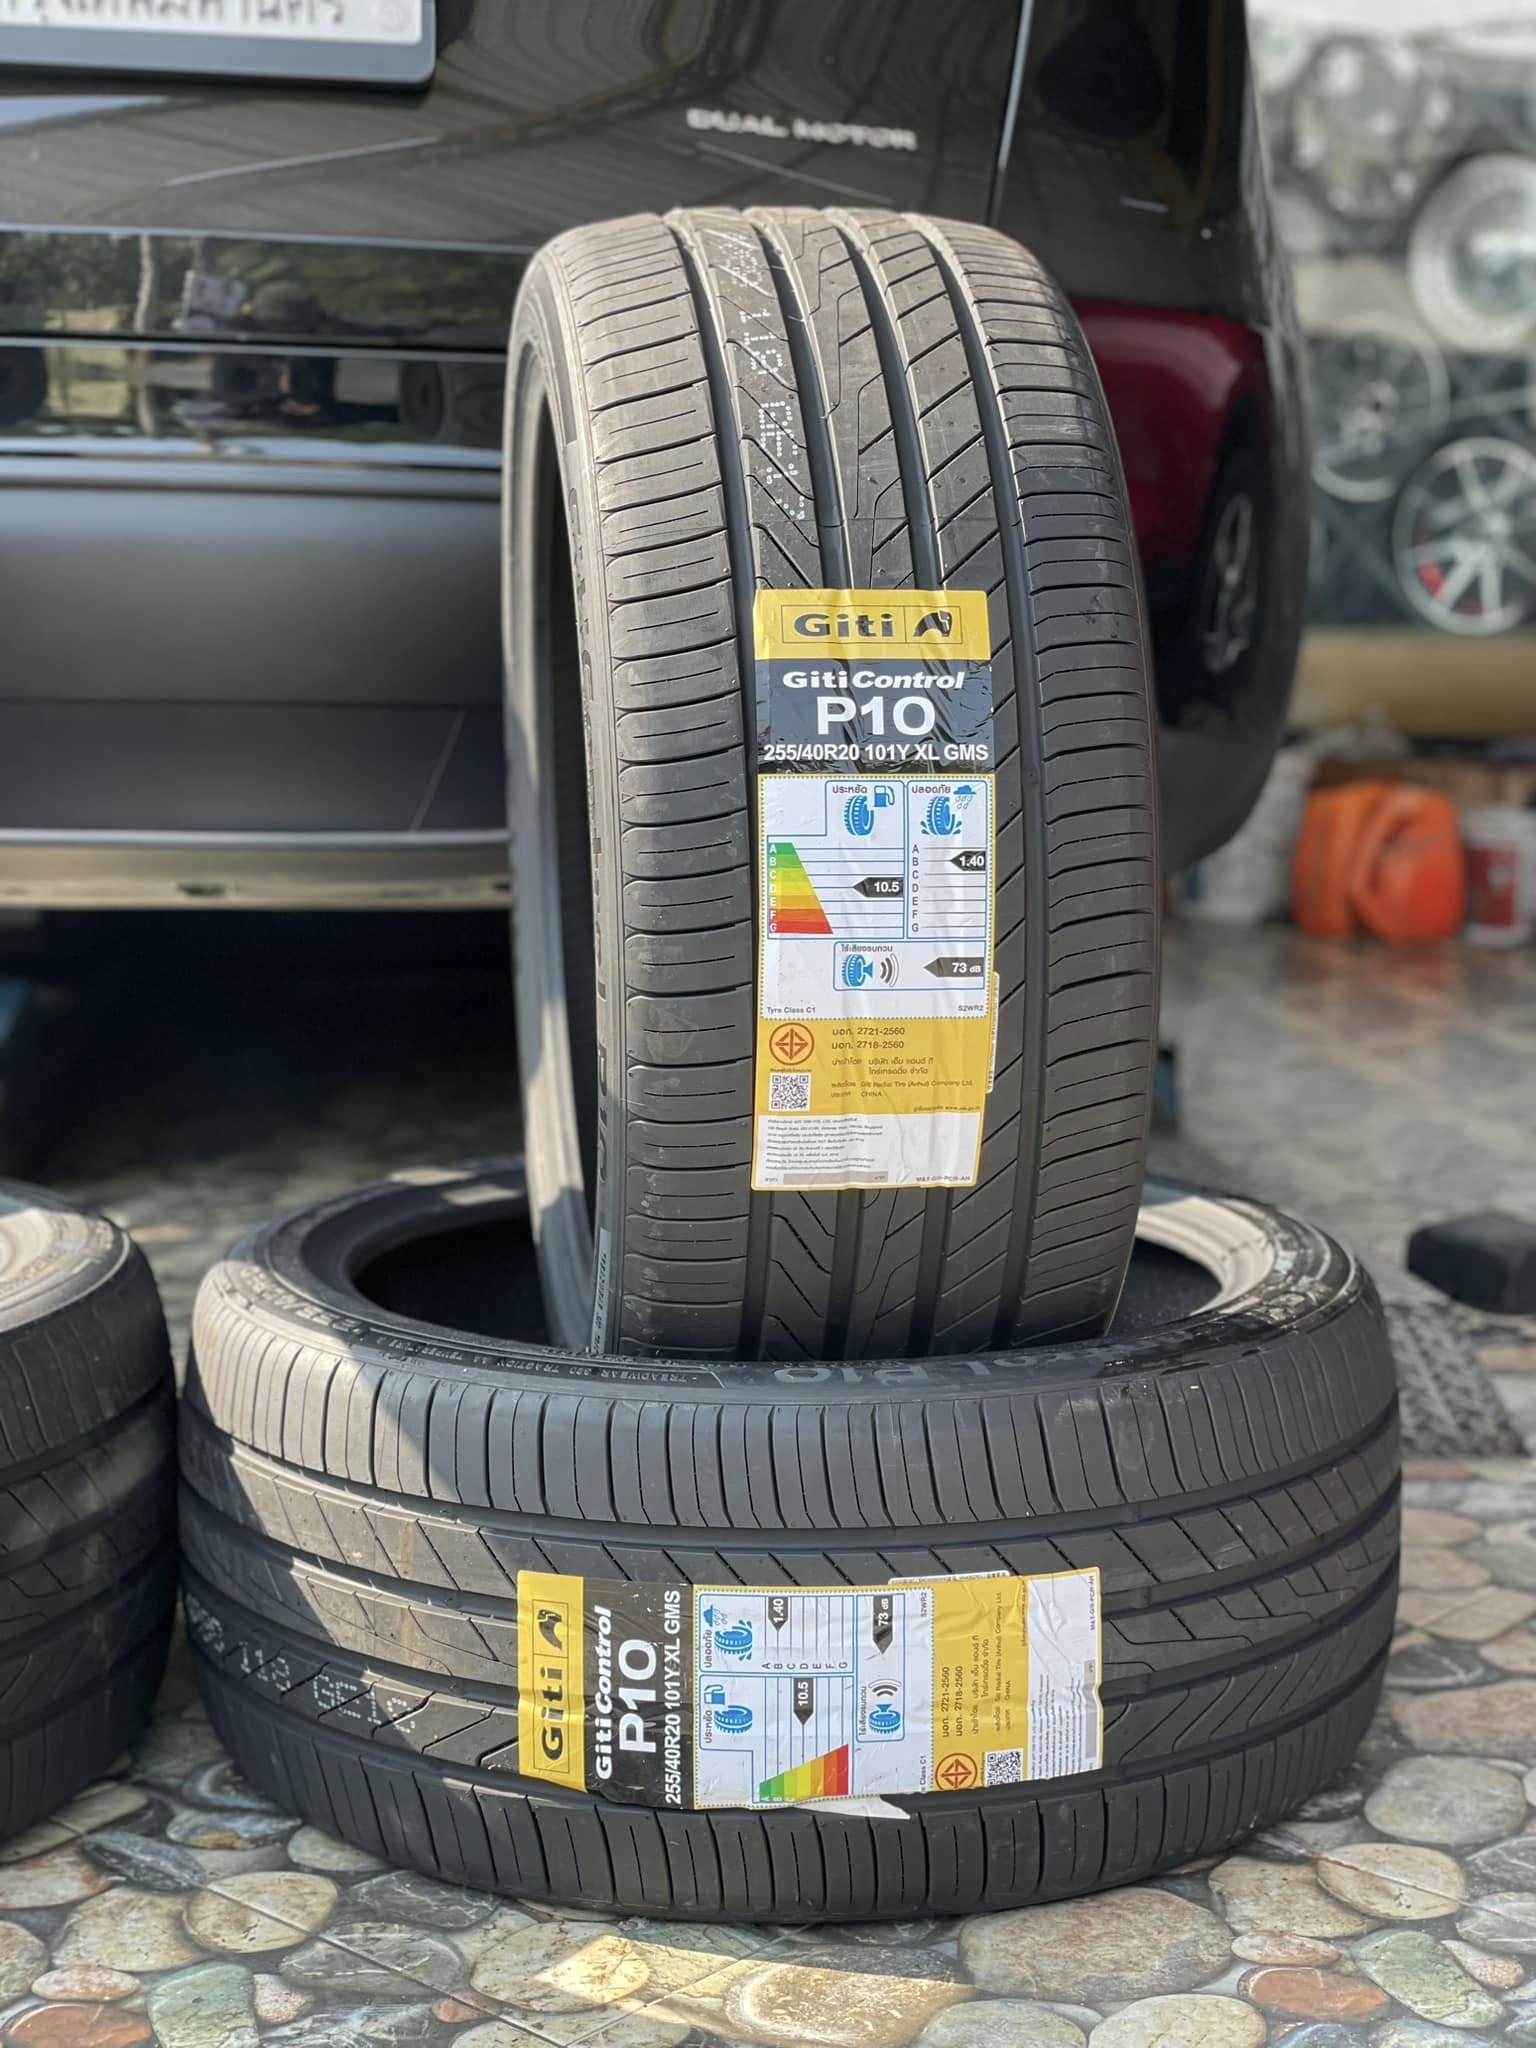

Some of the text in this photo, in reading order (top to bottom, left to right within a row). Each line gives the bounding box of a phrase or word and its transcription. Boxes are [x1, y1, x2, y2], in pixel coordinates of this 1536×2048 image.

[686, 107, 917, 151] DUAL MOTOR
[793, 613, 894, 638] Giti
[782, 670, 965, 689] GitiControl
[817, 696, 936, 736] P10
[764, 743, 989, 761] 255/40R20 101Y XL GMS
[832, 784, 868, 795] ประหยัด
[912, 784, 951, 795] ปลอดภัย
[769, 844, 777, 854] A
[912, 844, 919, 854] A
[769, 857, 776, 867] B
[912, 857, 919, 867] B
[958, 855, 984, 867] 1.40
[912, 870, 919, 880] C
[874, 881, 900, 892] 10.5
[912, 883, 919, 893] D
[912, 897, 918, 906] E
[770, 910, 776, 920] F
[912, 910, 918, 919] F
[769, 923, 777, 932] G
[912, 923, 919, 932] G
[951, 963, 981, 973] 73 dB
[767, 1006, 816, 1015] Tyre Class C1
[832, 1027, 905, 1036] มอก. 2721-2560
[832, 1040, 904, 1049] มอก. 2718-2560
[773, 1599, 784, 1624] 1.40
[879, 1598, 889, 1626] 73 dB
[703, 1629, 713, 1668] ปลอดภัย
[762, 1662, 771, 1670] A
[838, 1661, 848, 1669] G
[594, 1605, 613, 1780] GitiControl
[798, 1681, 809, 1707] 10.5
[941, 1667, 950, 1712] 2721-2560
[955, 1666, 963, 1711] 2718-2560
[617, 1639, 657, 1753] P10
[664, 1590, 682, 1804] 255/40R20 101Y XL GMS
[540, 1666, 564, 1761] Giti
[703, 1709, 713, 1744] ประหยัด
